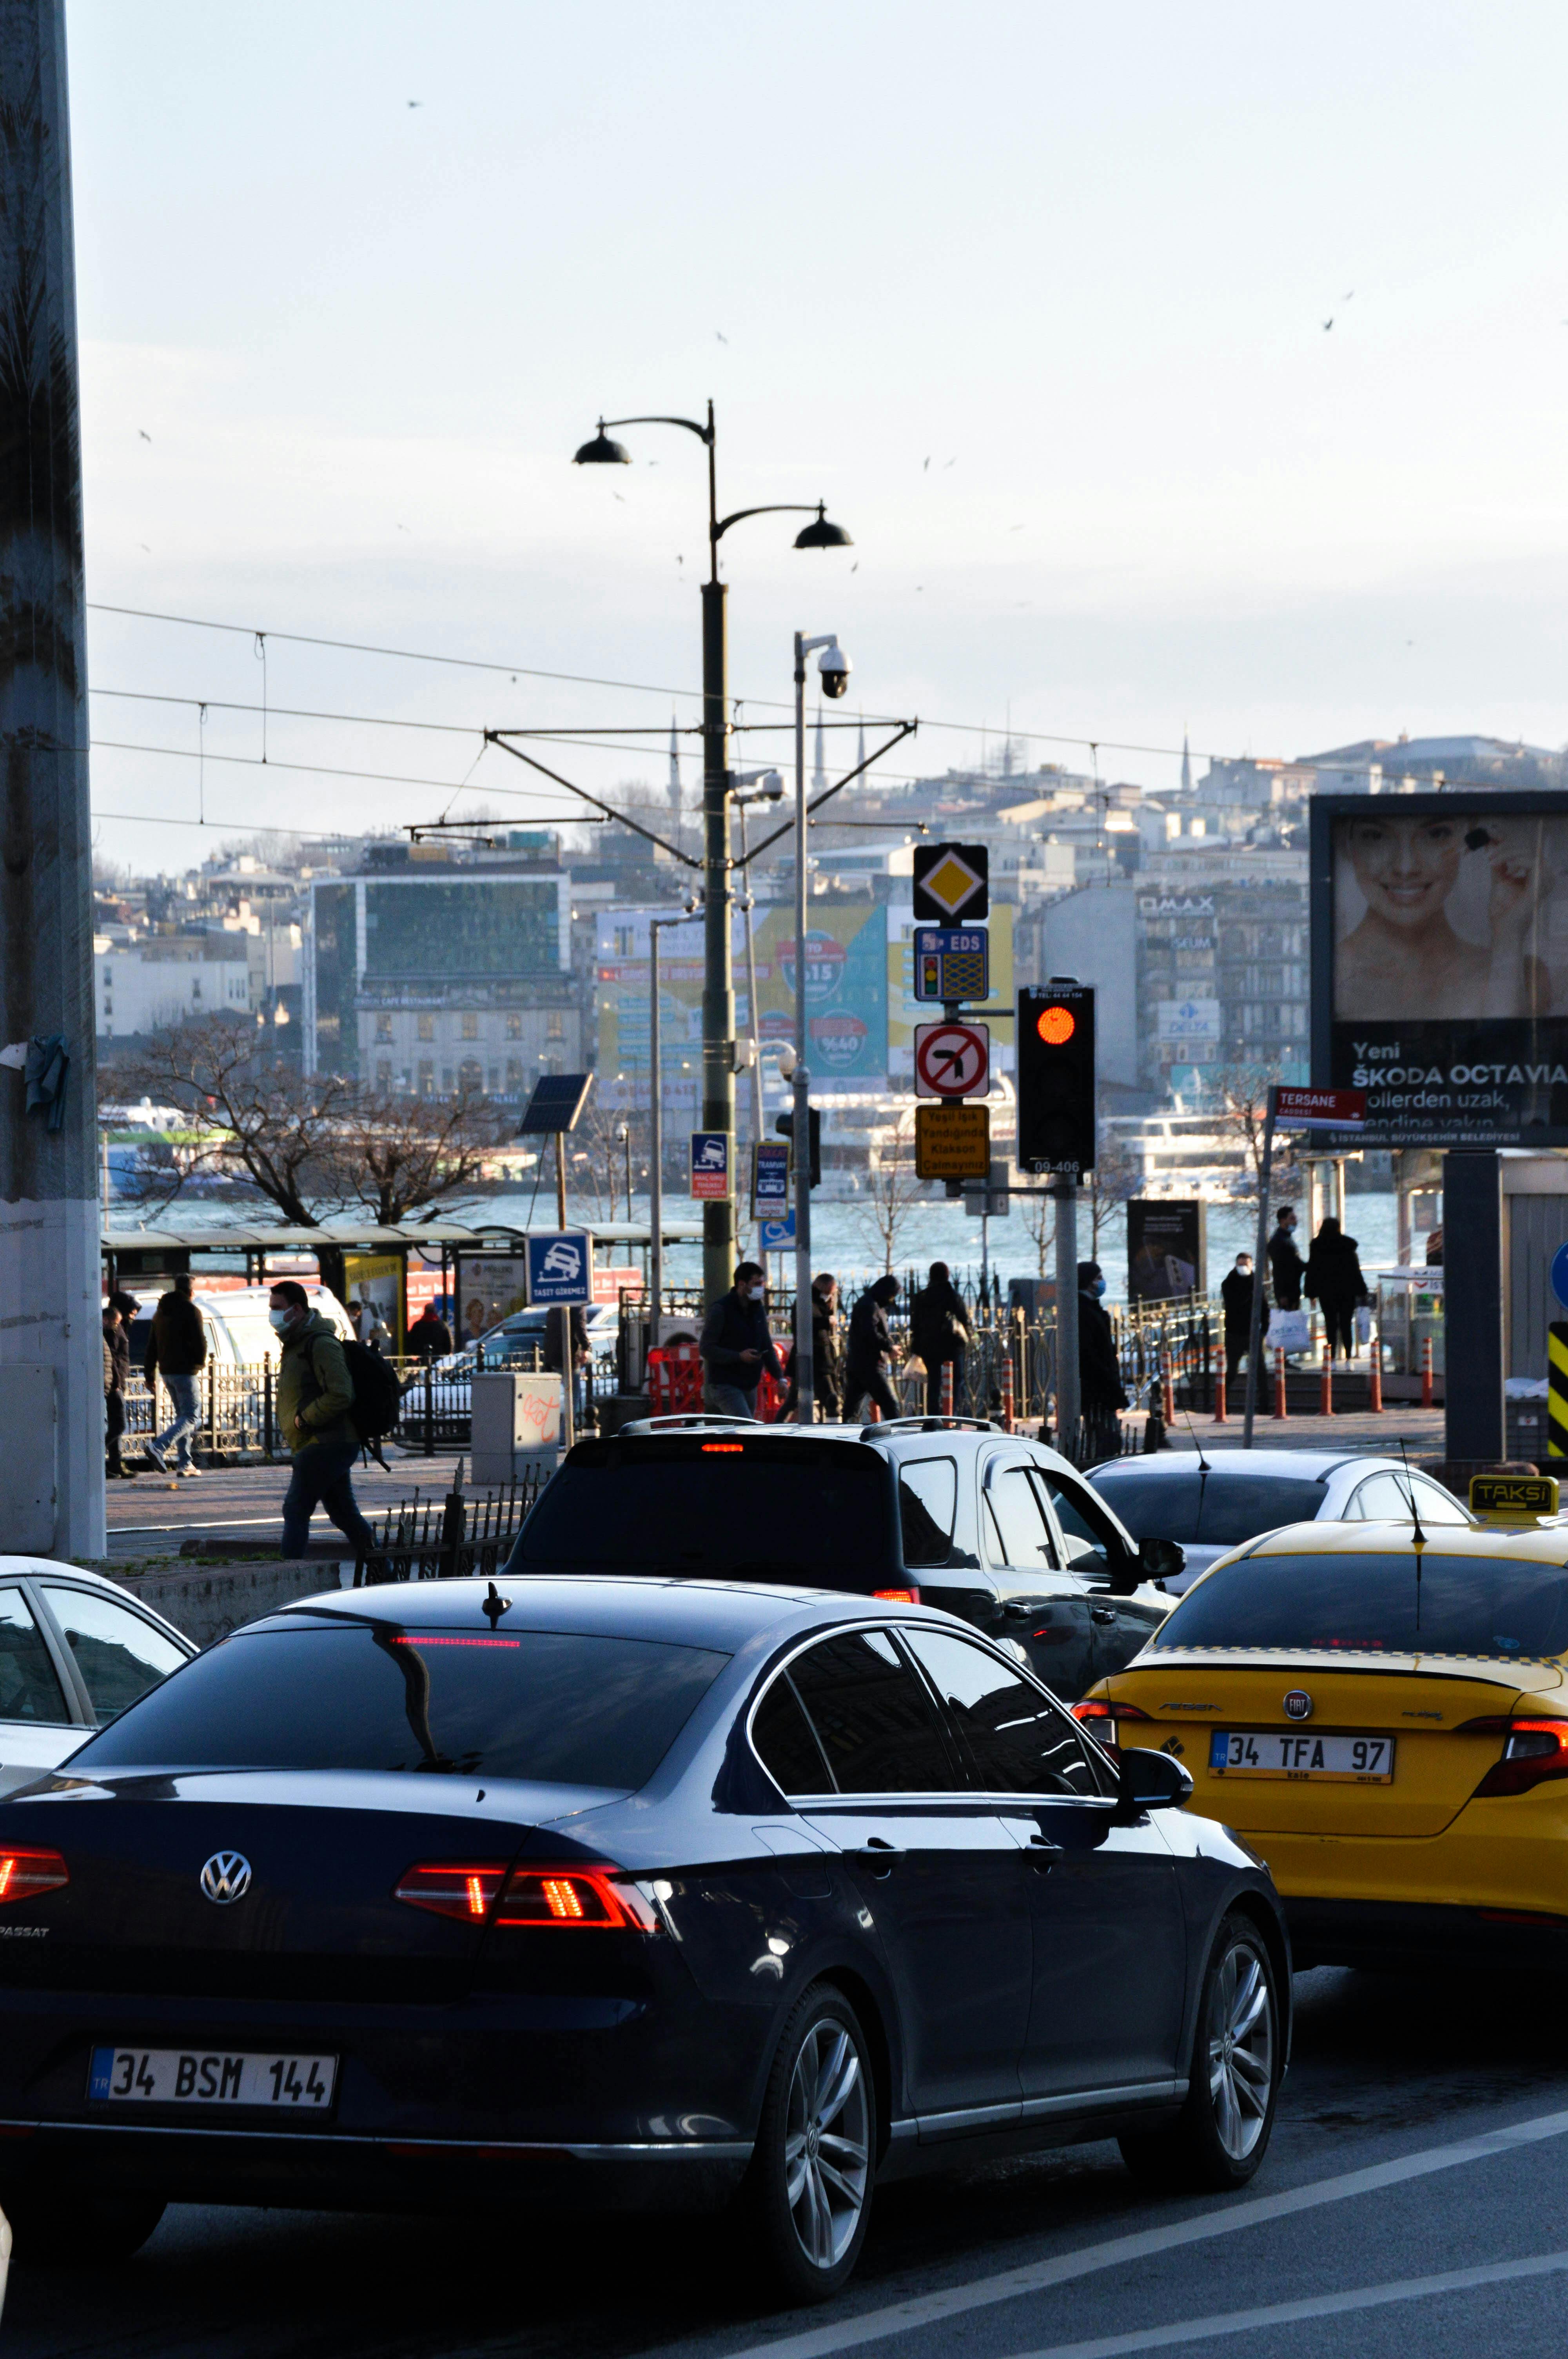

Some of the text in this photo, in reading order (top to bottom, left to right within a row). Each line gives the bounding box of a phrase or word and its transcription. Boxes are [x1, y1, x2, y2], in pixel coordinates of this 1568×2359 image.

[951, 936, 980, 951] EDS
[1352, 1041, 1400, 1060] Yeni
[1352, 1064, 1568, 1088] ŠKODA OCTAVIA
[1280, 1092, 1337, 1108] TERSANE
[1367, 1090, 1510, 1111] ollerden uzak,
[1365, 1114, 1434, 1128] endine
[931, 1144, 976, 1154] Klakson
[1034, 1161, 1079, 1172] 09-406
[555, 1286, 586, 1296] GİREMEZ
[1289, 1699, 1306, 1711] FIAT
[1216, 1753, 1226, 1762] TR
[1229, 1737, 1385, 1770] 34 TFA 97
[1287, 1771, 1309, 1779] kale
[0, 1926, 50, 1938] PASSAT
[93, 2078, 109, 2090] TR
[113, 2054, 326, 2102] 34 BSM 144
